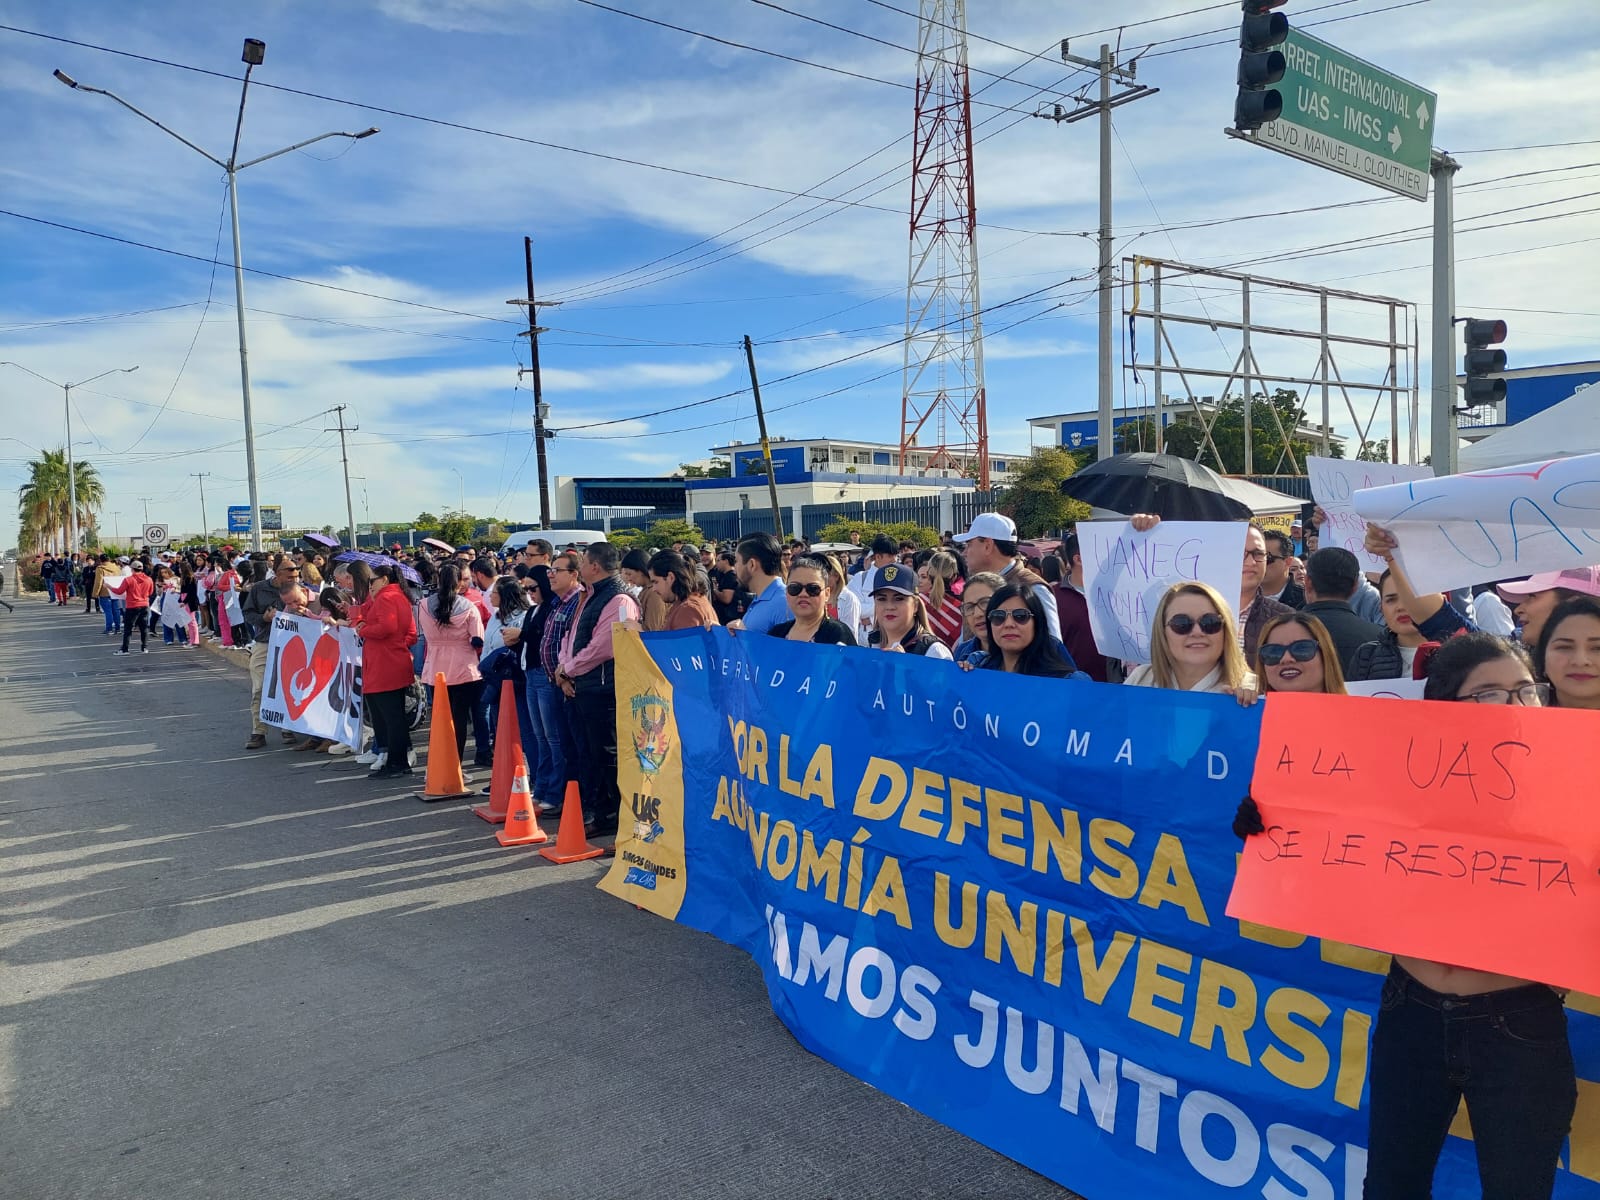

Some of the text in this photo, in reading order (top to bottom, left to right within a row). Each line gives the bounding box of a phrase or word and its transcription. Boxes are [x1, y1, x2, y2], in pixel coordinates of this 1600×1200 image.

[1297, 85, 1330, 121] UAS
[1343, 105, 1382, 142] IMSS
[1325, 59, 1411, 120] INTERNACIONAL
[1267, 121, 1421, 190] BLVD. MANUEL J. CLOUTHIER
[1317, 471, 1350, 501] NO
[150, 529, 162, 538] 60
[267, 646, 281, 699] I
[873, 687, 1133, 767] AUTÓNOMA
[1276, 736, 1532, 804] A LA UAS
[631, 792, 662, 825] UAS
[779, 732, 836, 810] LA
[853, 755, 1211, 927] DEFENSA
[1256, 825, 1577, 897] SE LE RESPETA
